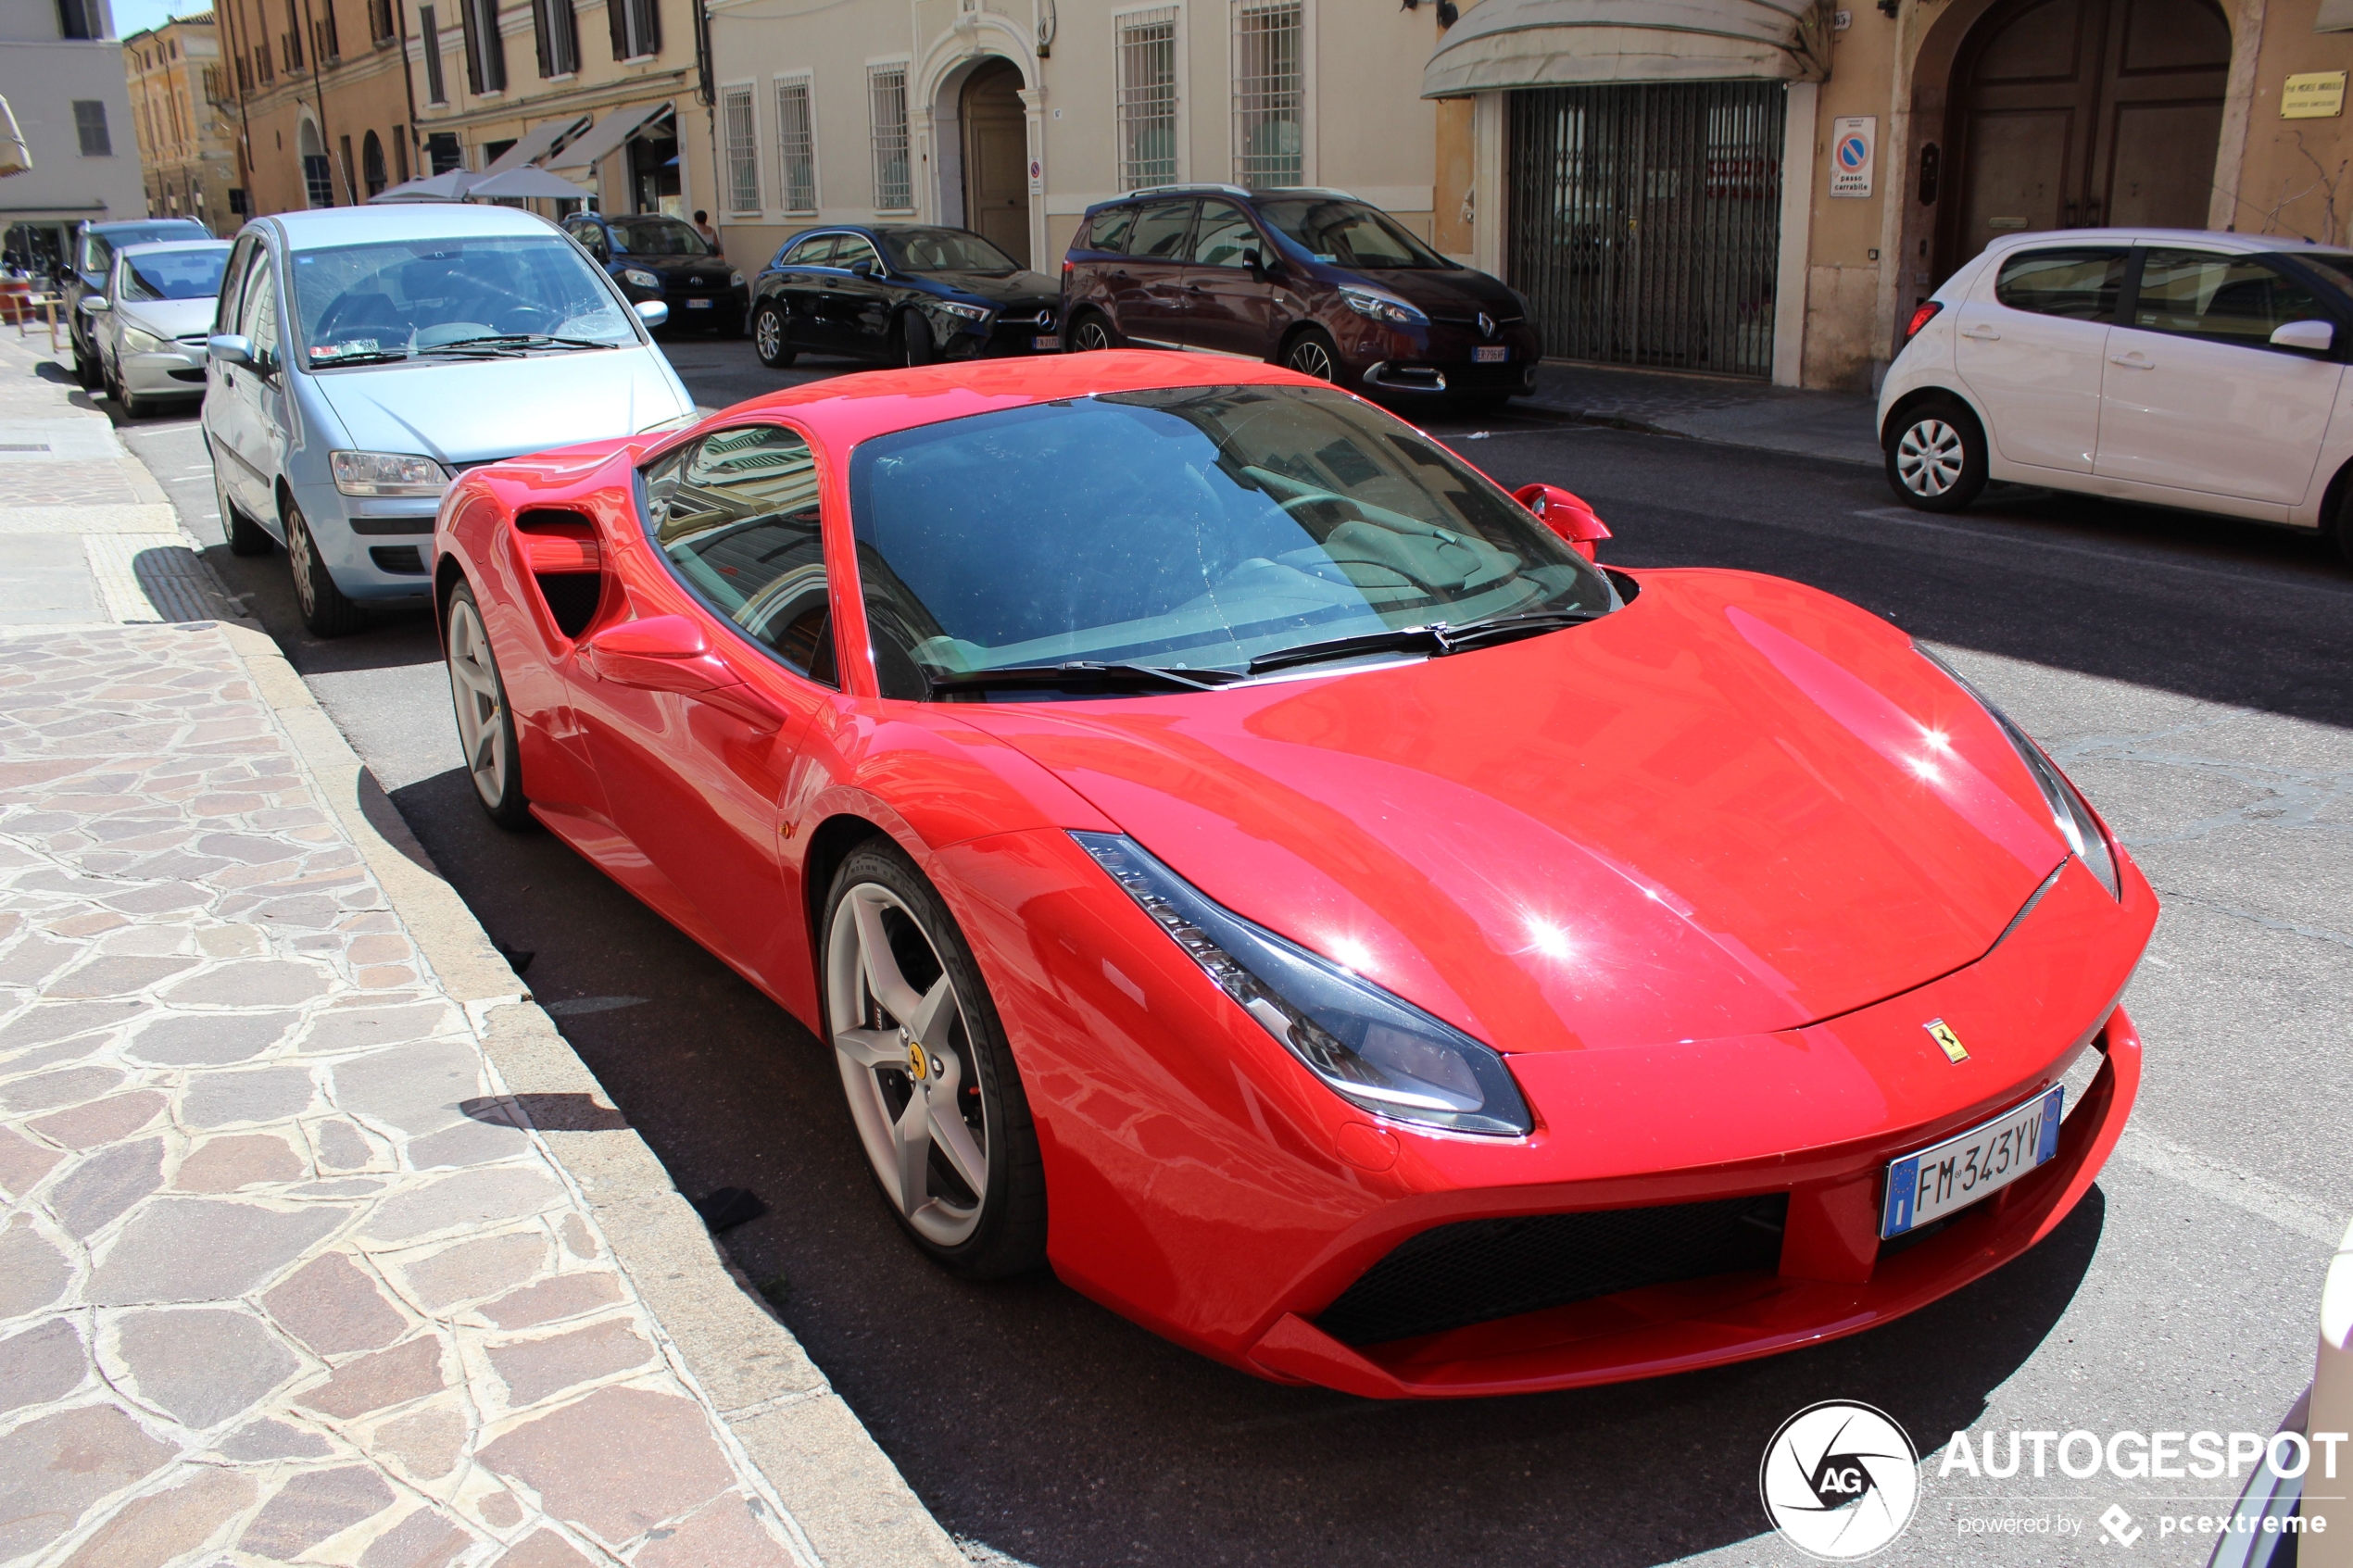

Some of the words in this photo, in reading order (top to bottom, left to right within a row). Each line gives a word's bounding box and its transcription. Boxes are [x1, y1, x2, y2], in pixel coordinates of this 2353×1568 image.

[1840, 175, 1863, 183] passo
[1834, 182, 1869, 191] carrabile
[960, 987, 999, 1100] ZERO
